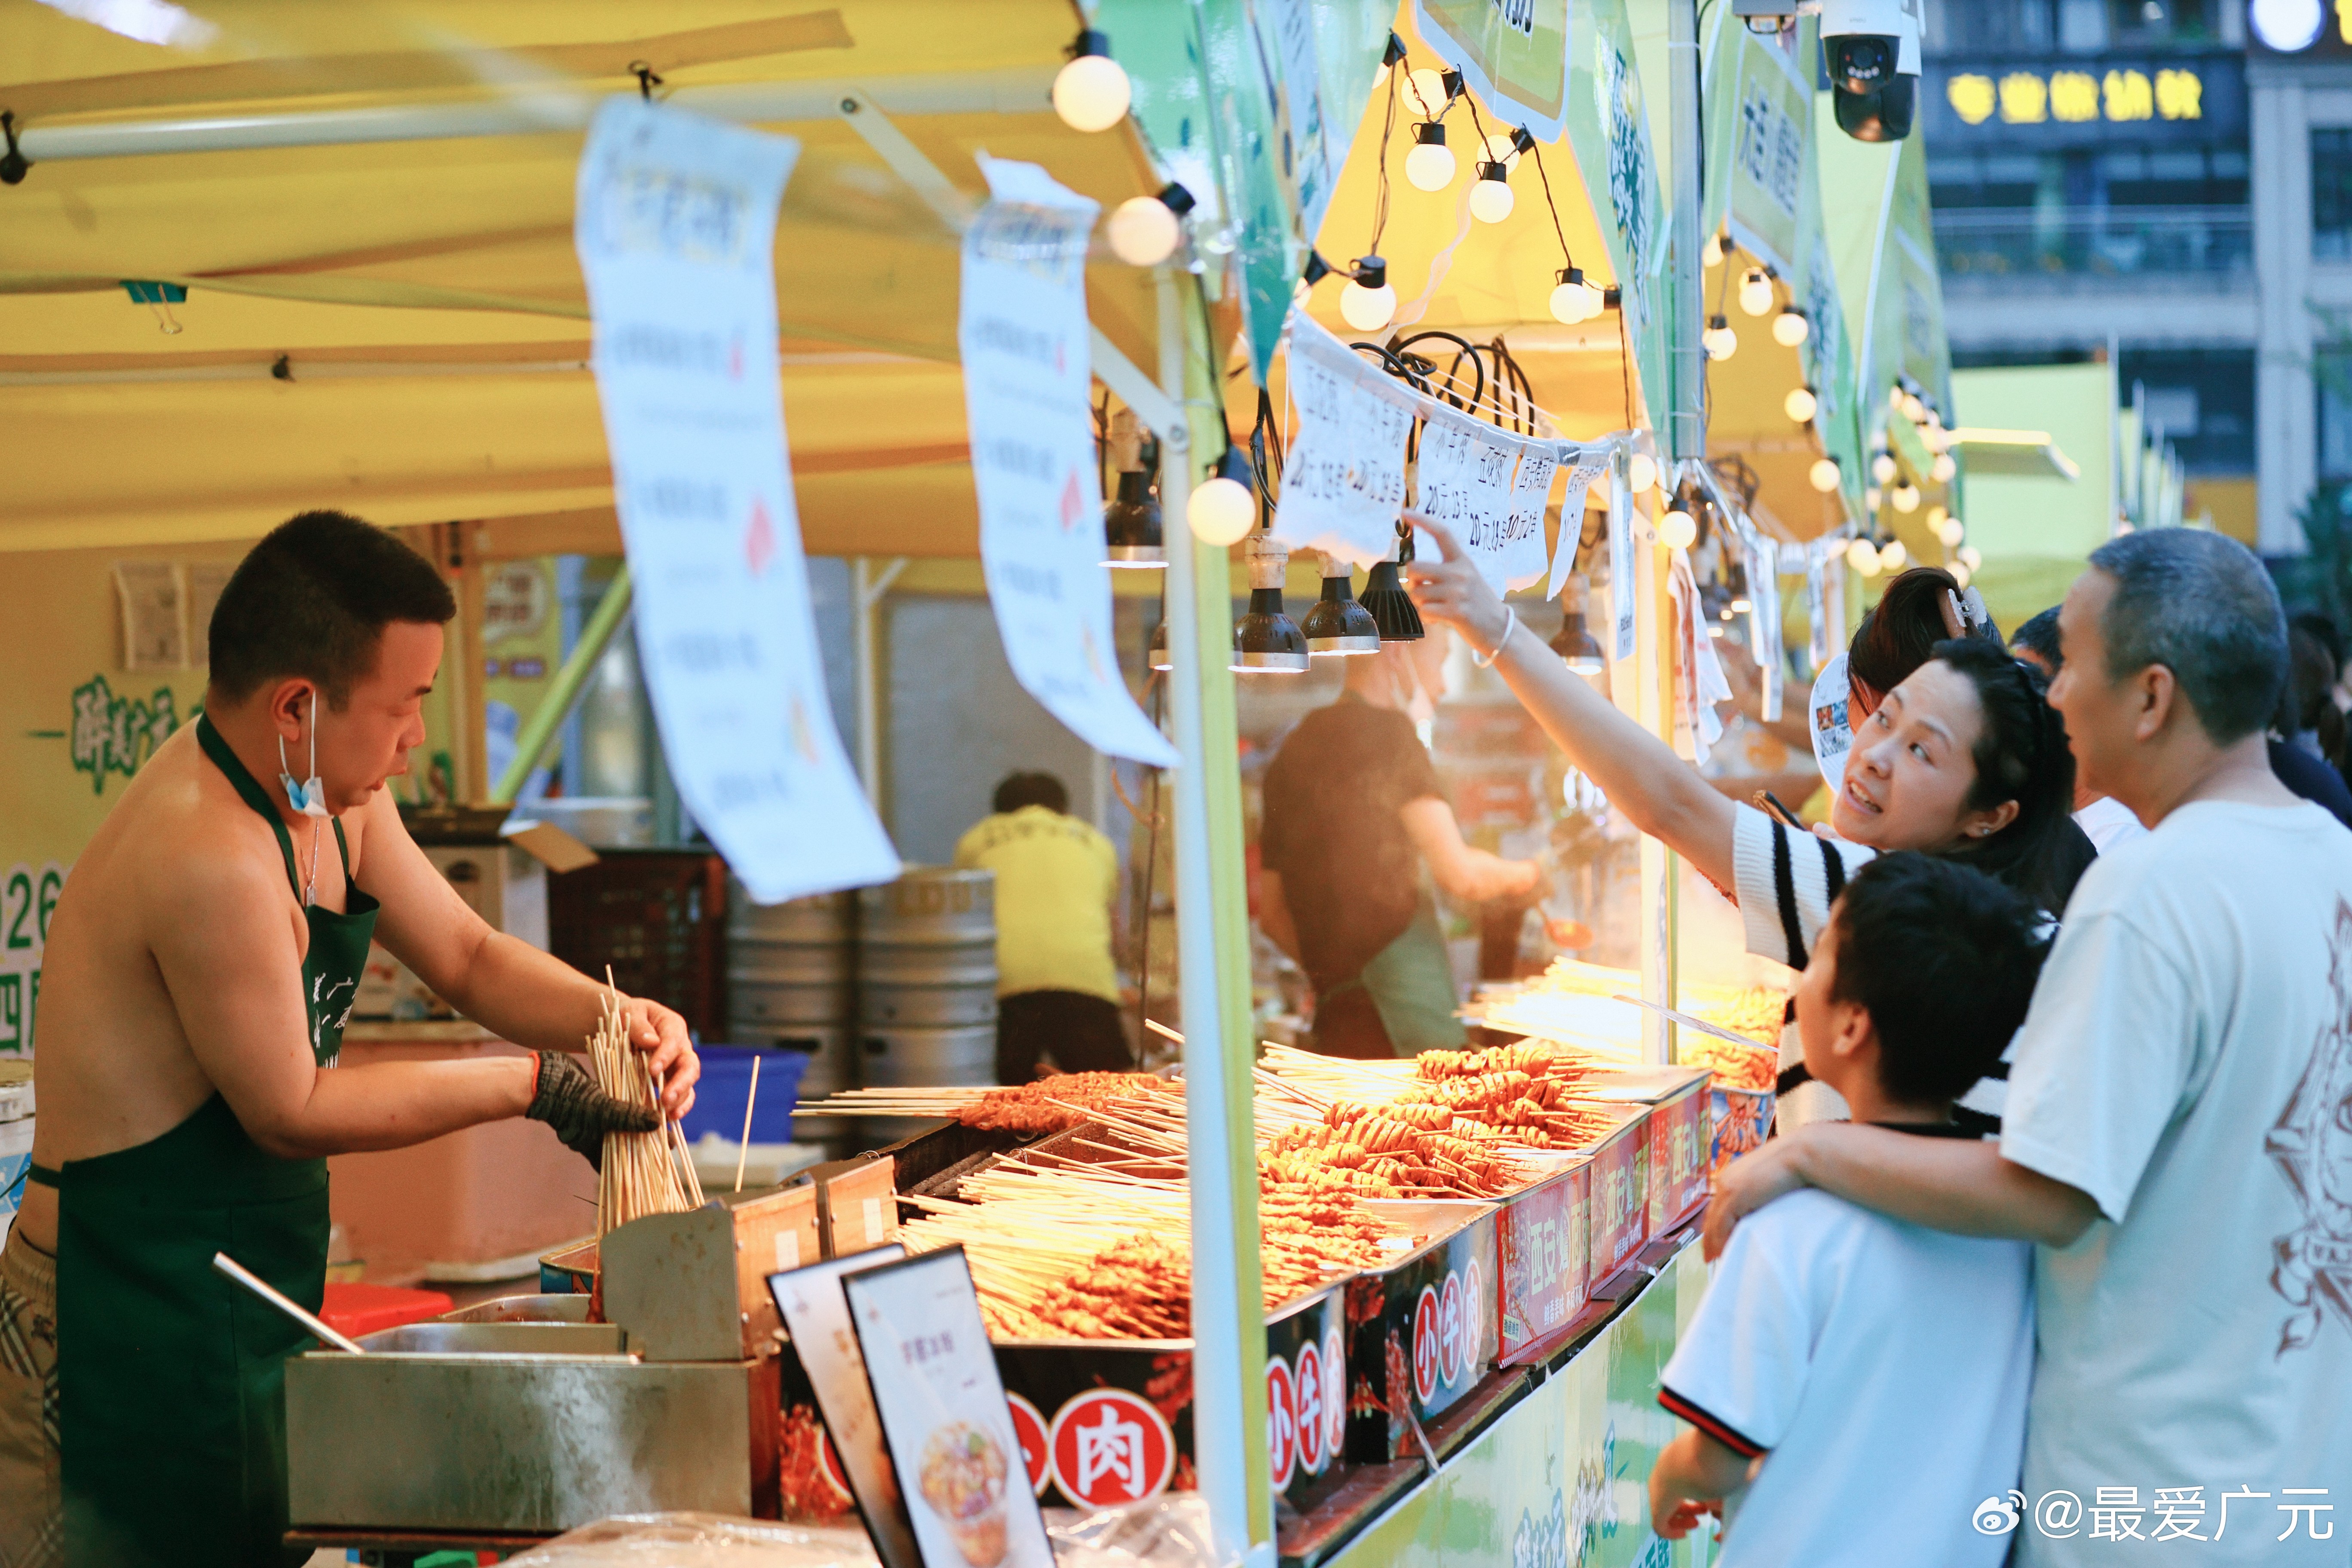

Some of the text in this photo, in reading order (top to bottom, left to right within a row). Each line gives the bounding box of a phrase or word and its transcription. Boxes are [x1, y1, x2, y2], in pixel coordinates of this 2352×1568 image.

[0, 872, 61, 948] 26
[1418, 1271, 1478, 1385] 小牛肉
[1076, 1404, 1145, 1498] 肉
